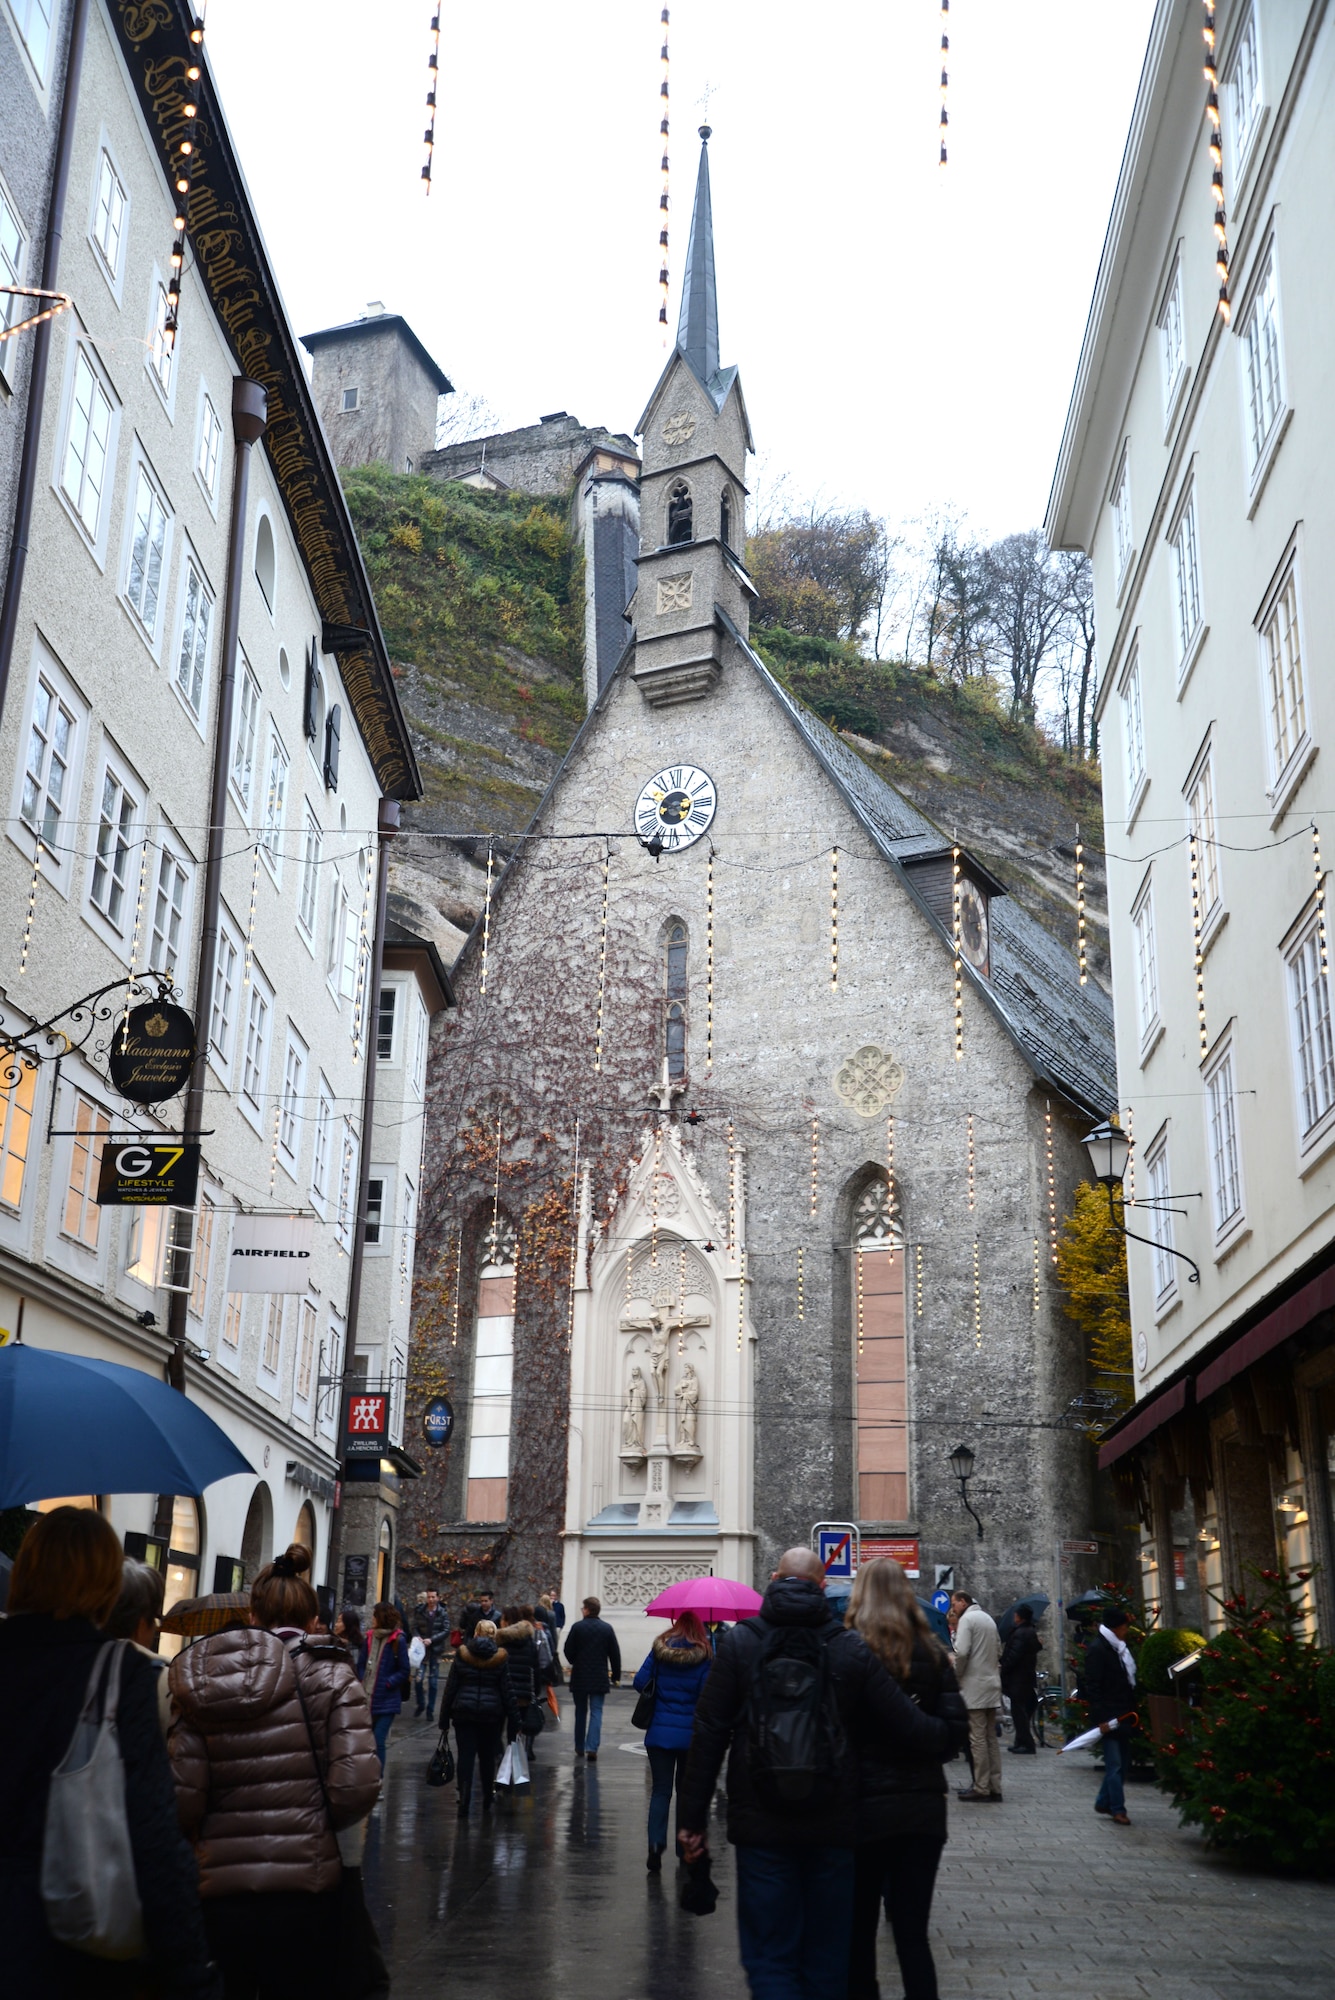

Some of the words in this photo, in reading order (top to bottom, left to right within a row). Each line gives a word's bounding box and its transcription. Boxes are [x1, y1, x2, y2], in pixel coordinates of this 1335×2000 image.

[144, 1058, 182, 1070] Exclusiv
[120, 1064, 177, 1088] Juwelen
[115, 1146, 184, 1178] G7
[232, 1248, 311, 1259] AIRFIELD
[424, 1414, 452, 1426] FÜRST
